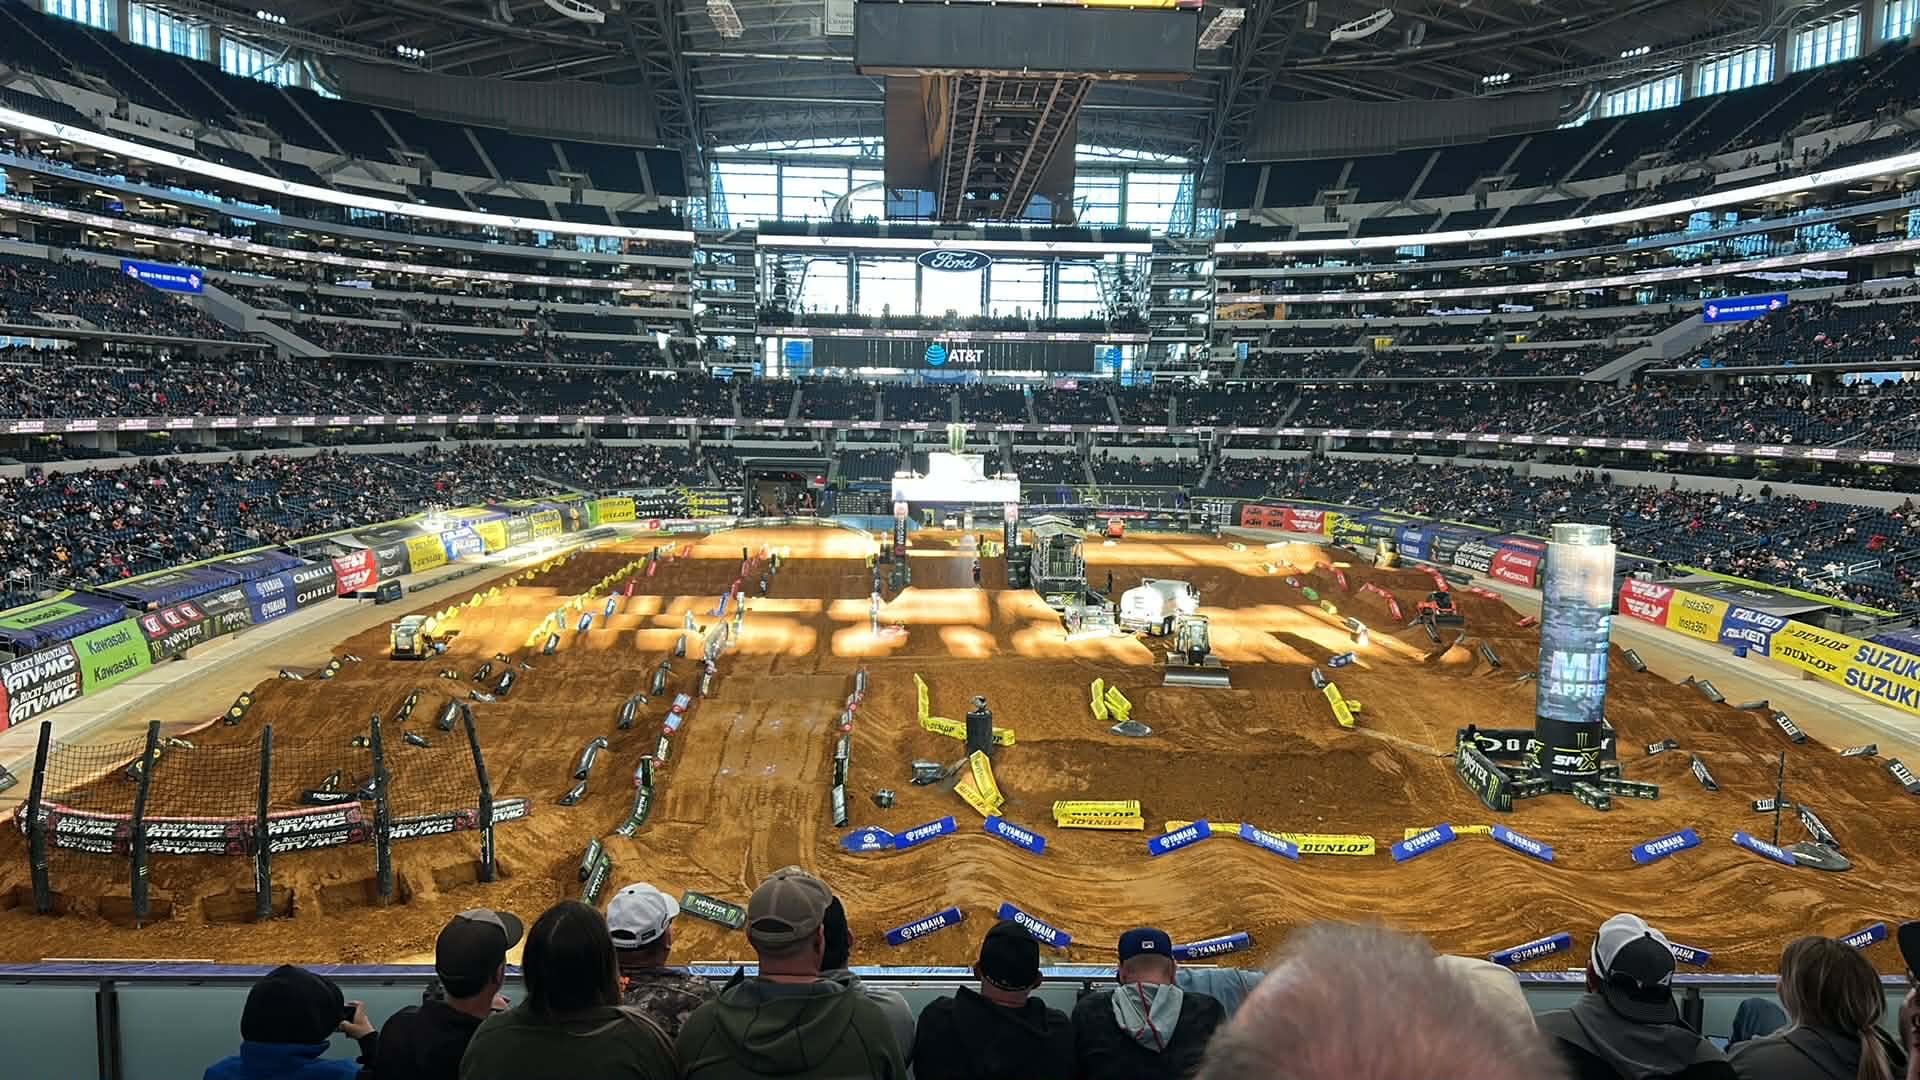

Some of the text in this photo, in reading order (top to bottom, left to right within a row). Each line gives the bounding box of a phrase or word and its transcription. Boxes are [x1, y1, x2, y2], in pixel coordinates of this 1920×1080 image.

[931, 252, 978, 268] Ford
[949, 349, 984, 362] AT&T
[1682, 598, 1713, 615] Insta360
[1679, 616, 1707, 635] Insta360
[1731, 607, 1783, 629] FALKEN
[86, 628, 131, 655] Kawasaki
[1723, 626, 1766, 645] FALKEN
[1794, 630, 1849, 651] DUNLOP
[11, 645, 69, 674] ROCKY MOUNTAIN
[93, 652, 138, 682] Kawasaki
[1783, 647, 1838, 672] DUNLOP
[1855, 645, 1920, 682] SUZUK
[19, 672, 77, 704] ROCKY MOUNTAIN
[1844, 668, 1919, 708] SUZUKI
[1552, 752, 1598, 771] SMX
[278, 811, 344, 826] ROCKY MOUNTAIN
[914, 822, 942, 839] YAMAHA
[1005, 824, 1033, 844] YAMAHA
[1169, 827, 1198, 843] YAMAHA
[1411, 829, 1441, 847] YAMAHA
[1260, 832, 1288, 851] YAMAHA
[1302, 843, 1370, 854] DUNLOP
[1513, 832, 1541, 853] YAMAHA
[1652, 834, 1685, 850] YAMAHA
[695, 897, 727, 914] MONSTER
[910, 914, 946, 935] YAMAHA
[1022, 914, 1057, 942] YAMAHA
[1198, 942, 1234, 956] YAMAHA
[1521, 942, 1557, 961] YAMAHA
[1671, 945, 1694, 960] MAHA
